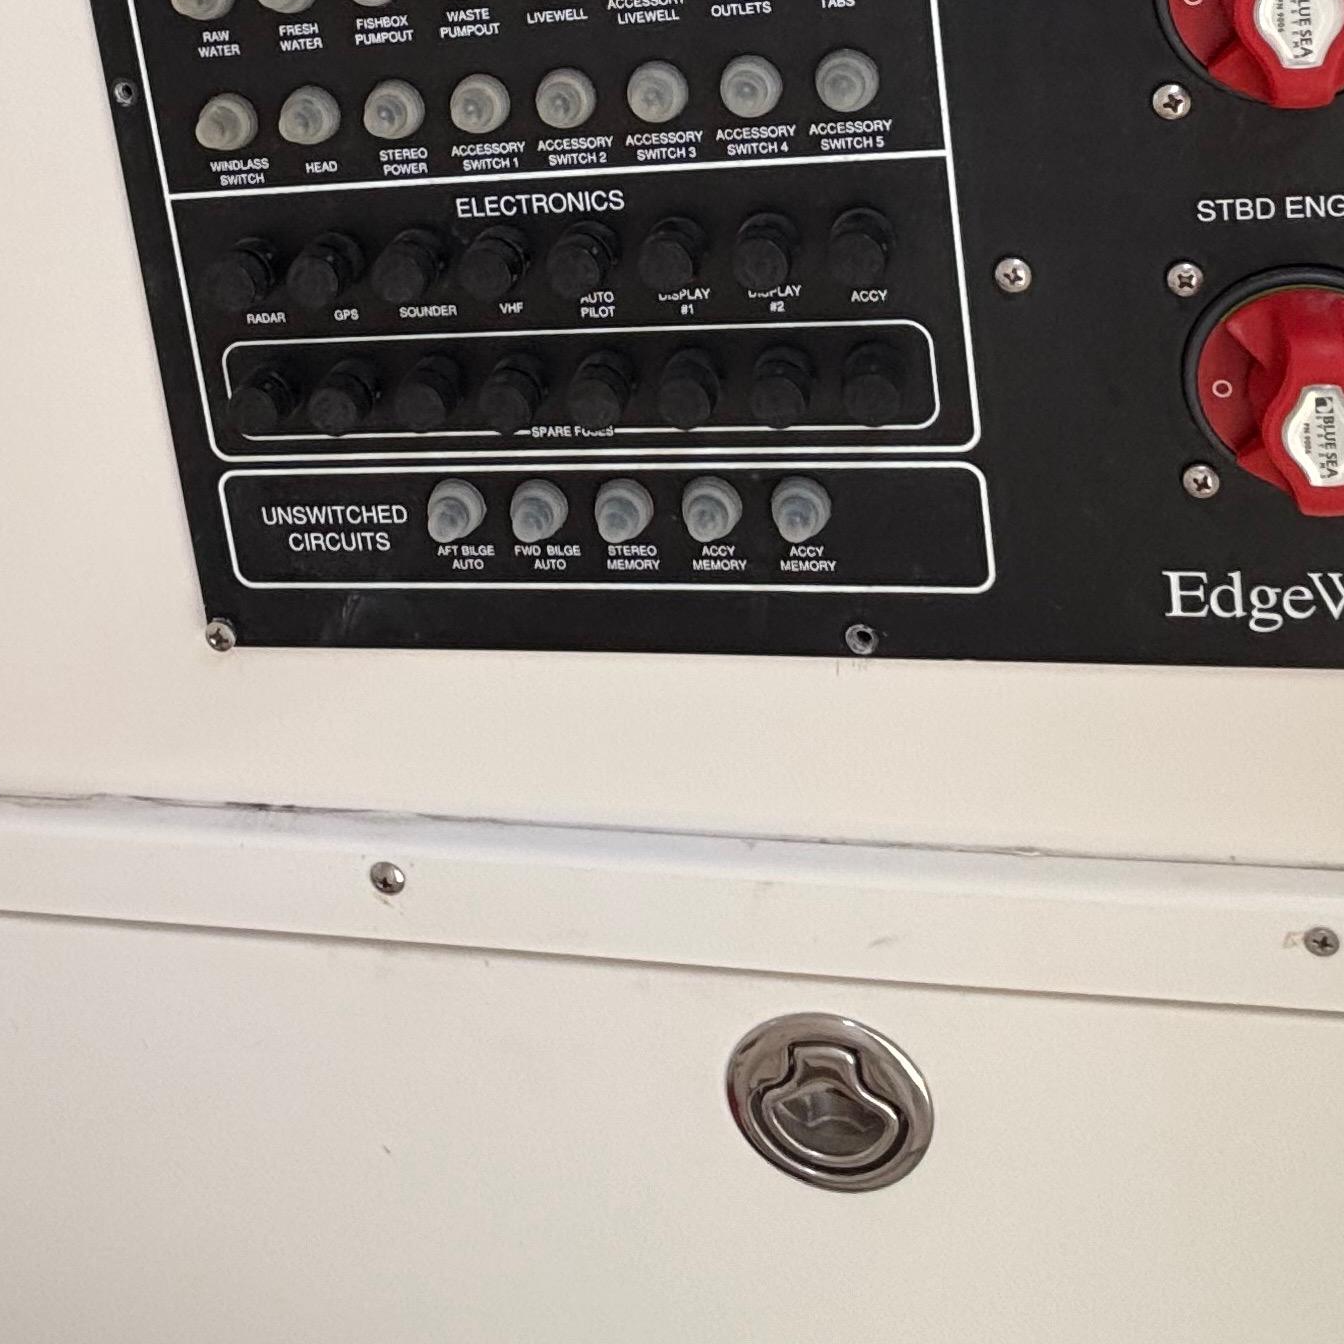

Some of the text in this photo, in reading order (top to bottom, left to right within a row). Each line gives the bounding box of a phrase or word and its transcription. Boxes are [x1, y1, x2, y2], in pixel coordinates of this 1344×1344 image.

[447, 8, 490, 22] WASTE
[711, 1, 771, 17] OUTLETS
[356, 15, 408, 29] FISHBOX
[527, 8, 588, 24] LIVEWELL
[618, 9, 679, 24] LIVEWELL
[279, 23, 318, 36] FRESH
[440, 23, 500, 38] PUMPOUT
[203, 31, 229, 42] RAW
[355, 30, 413, 45] PUMPOUT
[280, 37, 323, 51] WATER
[1300, 30, 1313, 57] SEA
[198, 44, 240, 57] WATER
[716, 125, 796, 140] ACCESSORY
[809, 119, 892, 135] ACCESSORY
[537, 136, 613, 151] ACCESSORY
[626, 131, 703, 146] ACCESSORY
[821, 136, 884, 150] SWITCH 5
[380, 148, 427, 161] STEREO
[451, 142, 525, 156] ACCESSORY
[637, 147, 696, 161] SWITCH 3
[727, 142, 788, 156] SWITCH 4
[210, 158, 269, 171] WINDLASS
[463, 157, 518, 171] SWITCH 1
[549, 152, 607, 166] SWITCH 2
[306, 161, 337, 173] HEAD
[383, 163, 428, 175] POWER
[220, 173, 264, 186] SWITCH
[471, 190, 624, 217] ELECTRONICS
[1197, 198, 1275, 221] STBD
[852, 290, 887, 302] ACCY
[400, 305, 457, 317] SOUNDER
[500, 302, 523, 313] VHF
[581, 306, 615, 318] PILOT
[247, 312, 286, 323] RADAR
[334, 309, 359, 320] GPS
[532, 426, 571, 437] SPARE
[1323, 415, 1338, 479] BLUE SEA
[262, 505, 407, 525] UNSWITCHED
[289, 532, 390, 551] CIRCUITS
[438, 545, 494, 556] AFT BILGE
[515, 545, 580, 556] FWD BILGE
[608, 545, 657, 556] STEREO
[702, 546, 735, 556] ACCY
[790, 546, 823, 557] ACCY
[453, 559, 484, 570] AUTO
[535, 559, 566, 570] AUTO
[607, 559, 660, 570] MEMORY
[693, 560, 746, 570] MEMORY
[781, 560, 836, 571] MEMORY
